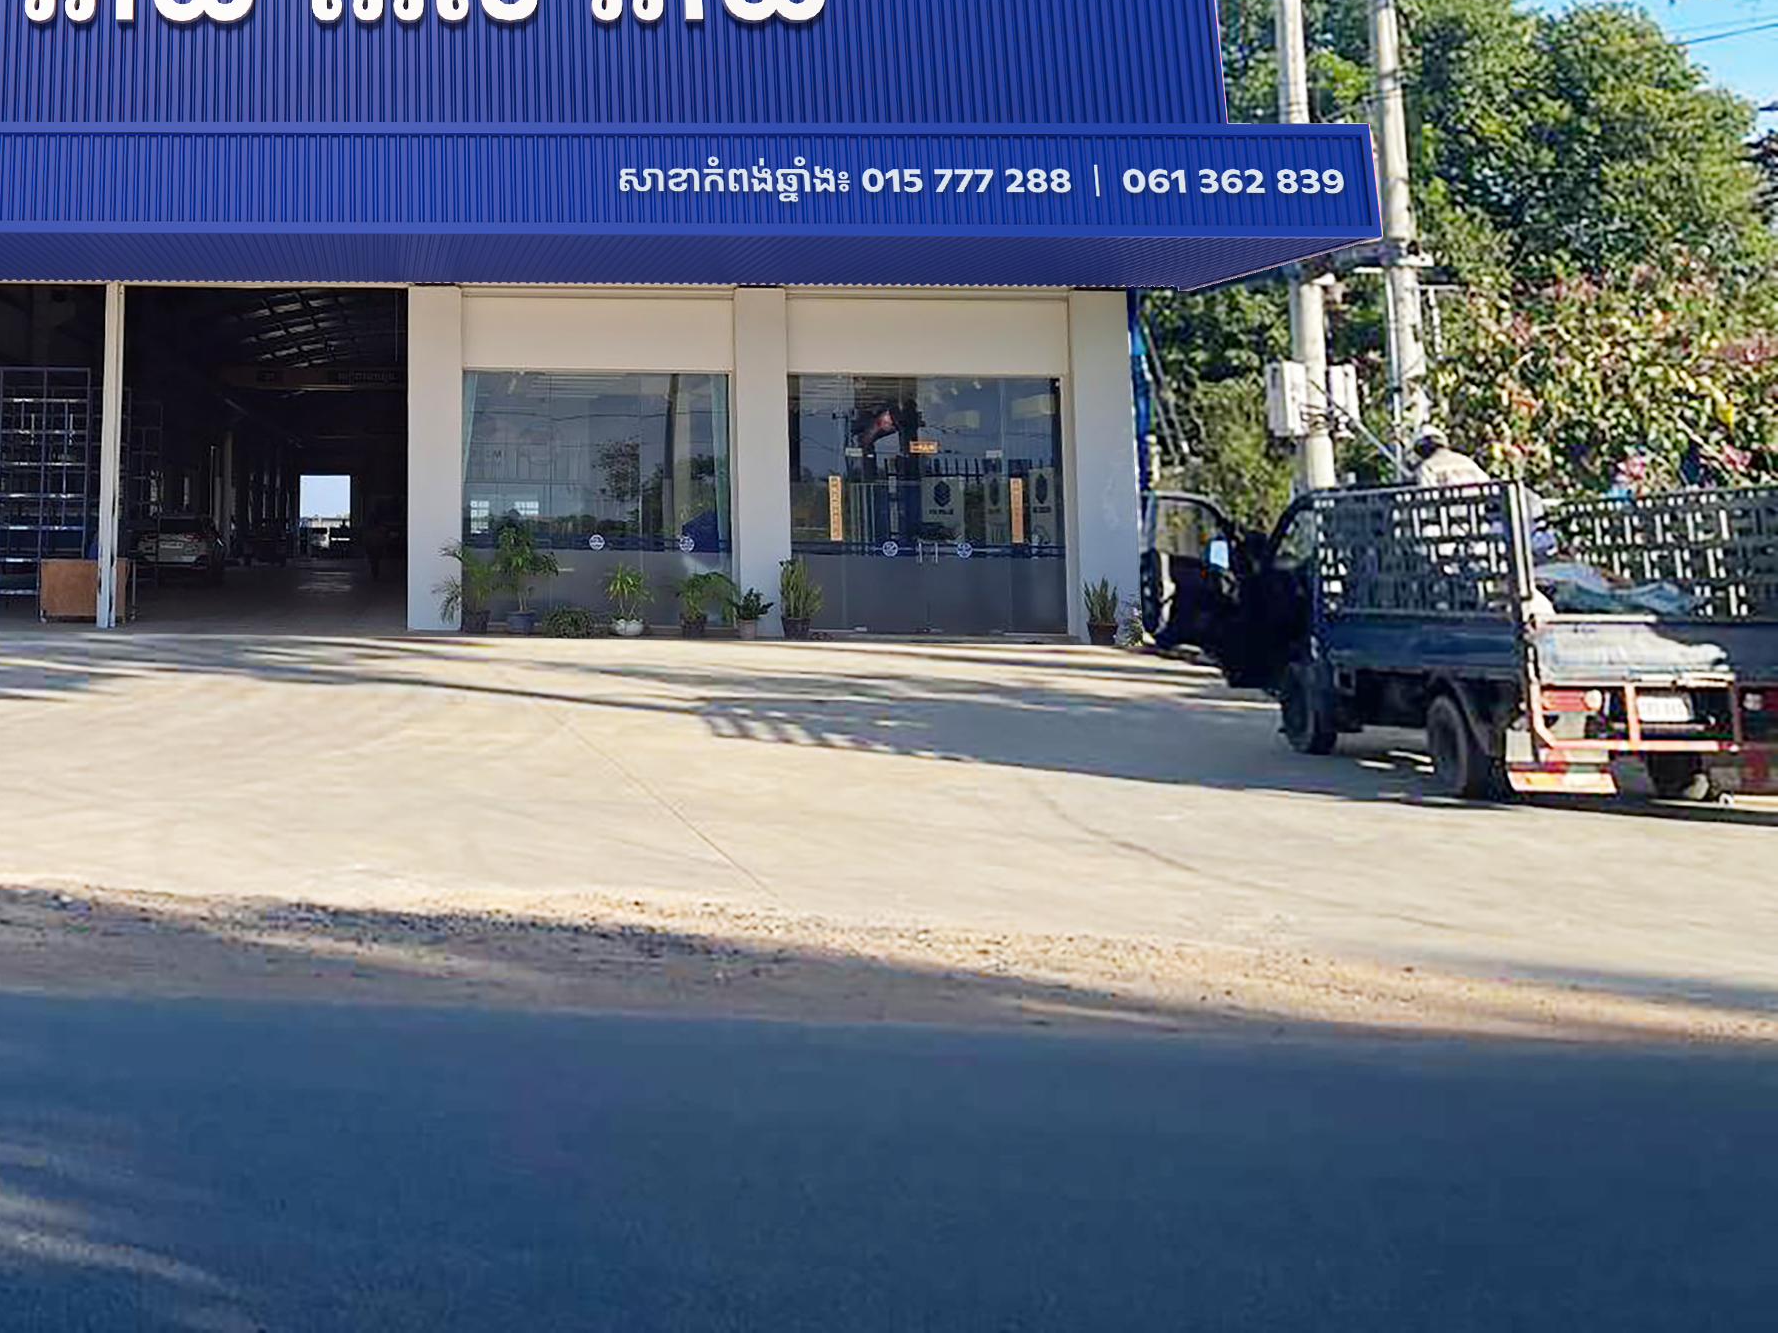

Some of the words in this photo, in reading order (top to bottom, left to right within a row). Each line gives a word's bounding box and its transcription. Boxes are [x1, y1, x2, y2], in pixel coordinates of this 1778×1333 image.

[861, 167, 924, 194] 015
[933, 168, 994, 194] 777
[1005, 168, 1072, 194] 288
[1122, 168, 1187, 195] 061
[1198, 168, 1266, 195] 362
[1276, 168, 1345, 195] 839
